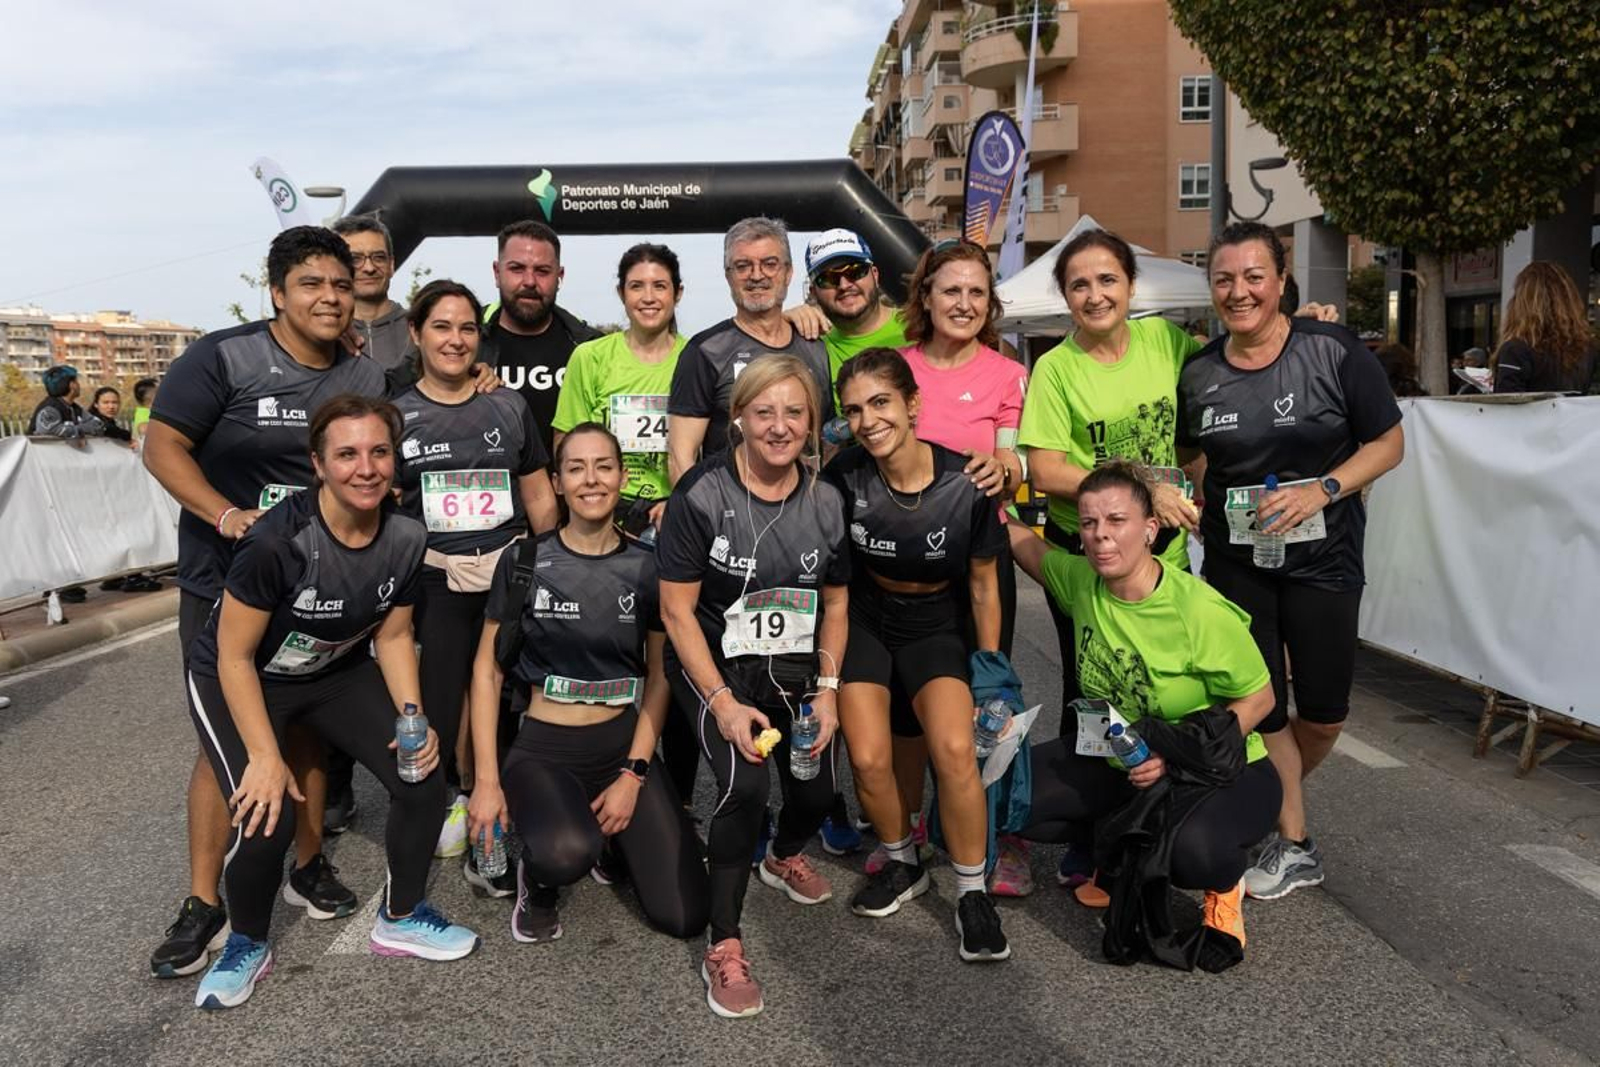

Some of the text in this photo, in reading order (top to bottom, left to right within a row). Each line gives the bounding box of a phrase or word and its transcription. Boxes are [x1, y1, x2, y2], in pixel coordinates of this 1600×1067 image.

[561, 183, 701, 198] Patronato Municipal de
[562, 197, 669, 213] Deportes de Jaén
[494, 365, 567, 390] UG
[282, 409, 307, 419] LCH
[1214, 413, 1238, 425] LCH
[636, 415, 669, 438] 24
[1086, 420, 1106, 444] 17
[424, 443, 450, 455] LCH
[442, 492, 496, 517] 612
[1232, 490, 1249, 505] XI
[869, 538, 896, 551] LCH
[729, 556, 757, 570] LCH
[315, 600, 344, 612] LCH
[554, 602, 579, 612] LCH
[749, 612, 785, 639] 19
